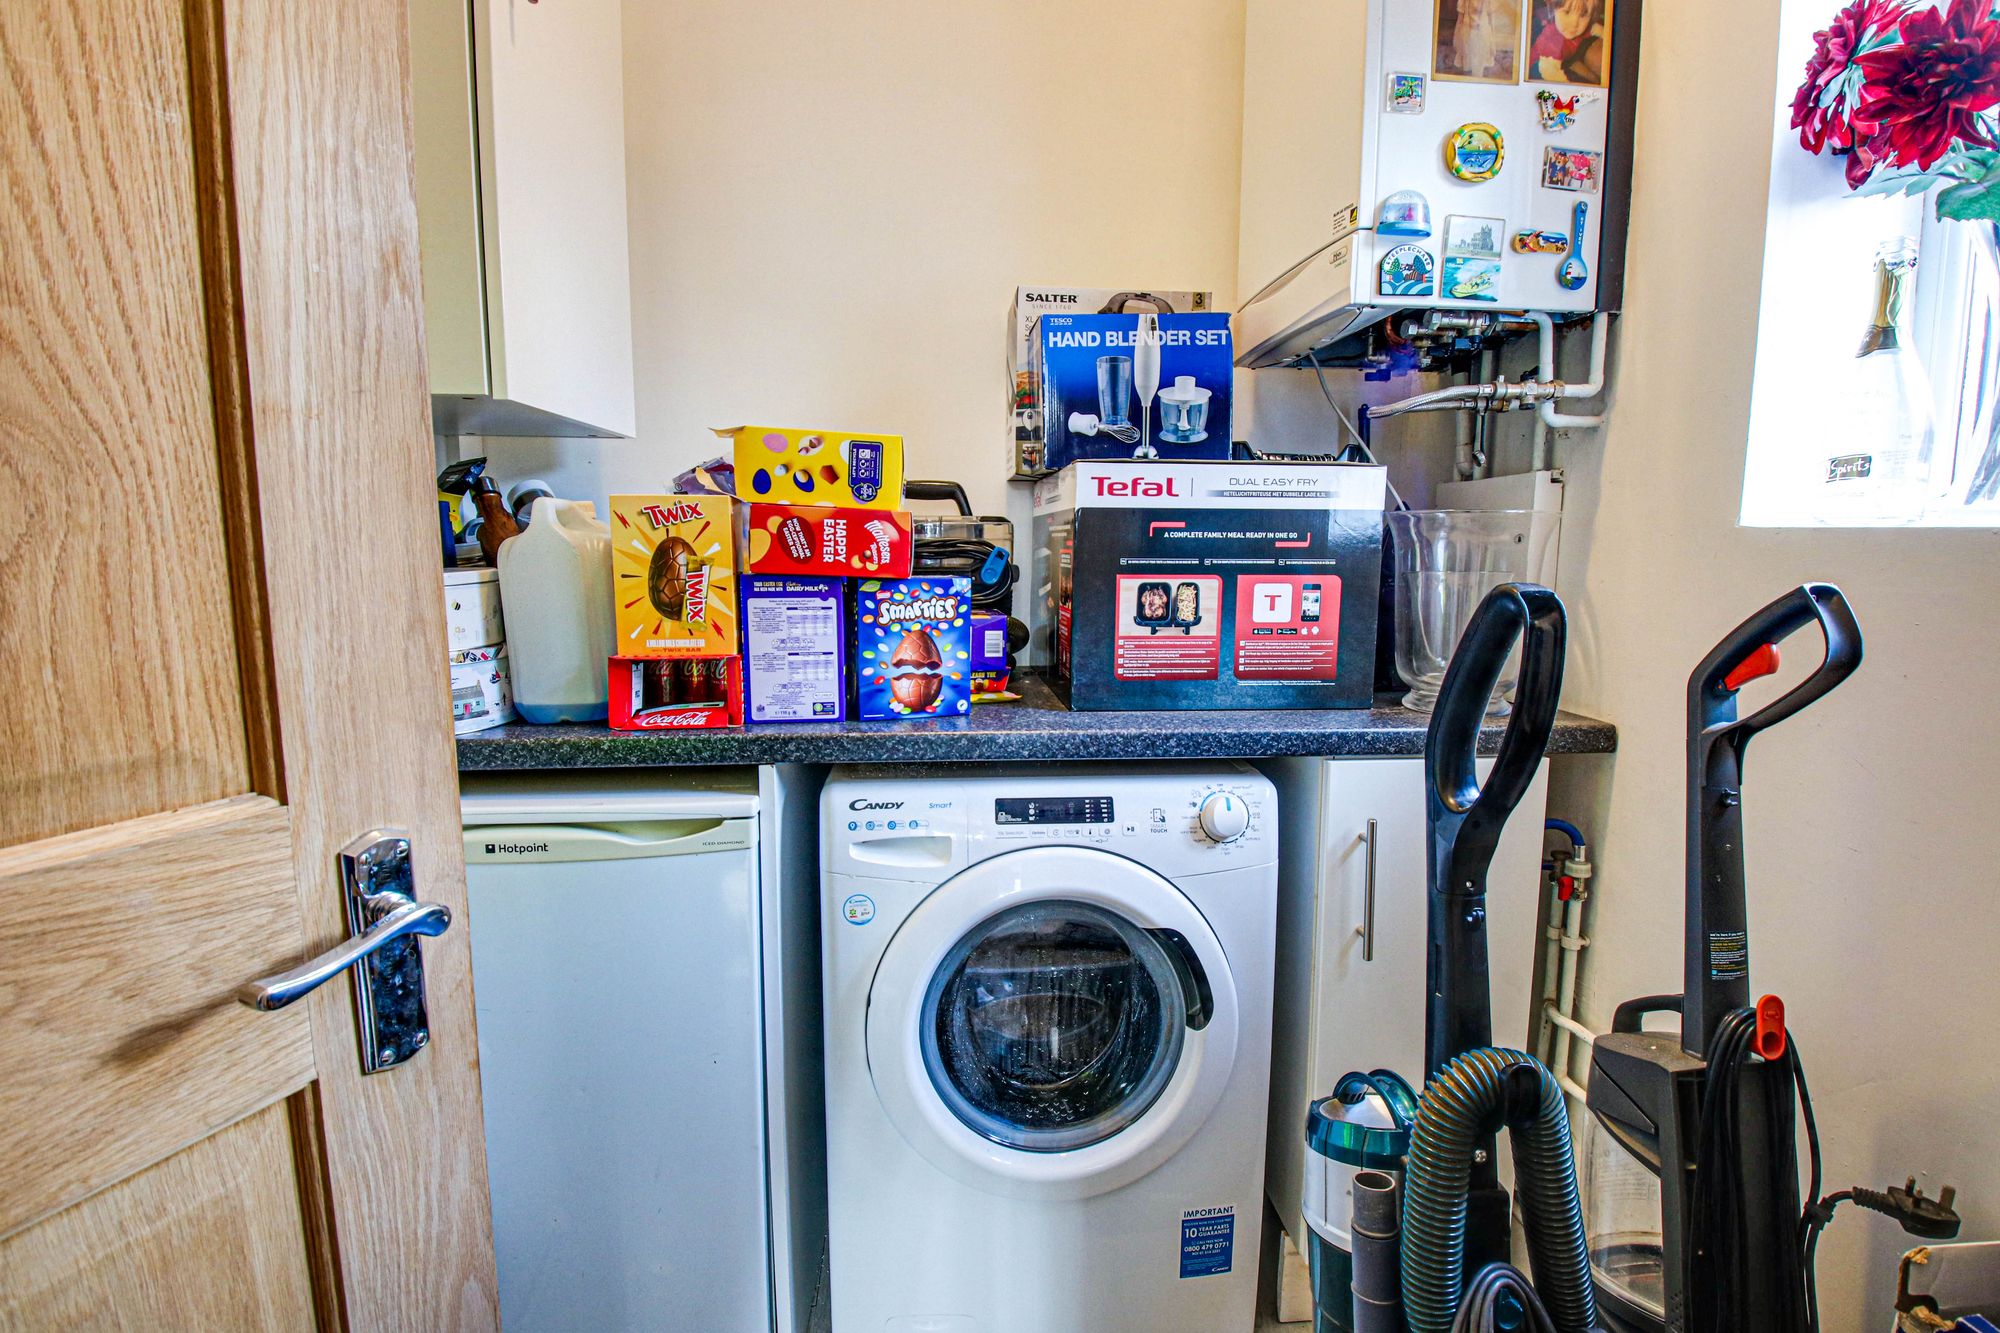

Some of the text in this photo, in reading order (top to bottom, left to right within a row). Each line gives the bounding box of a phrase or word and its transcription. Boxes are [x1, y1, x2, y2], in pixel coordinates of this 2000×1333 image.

[1025, 293, 1078, 303] SALTER
[1195, 292, 1203, 305] 3
[1049, 331, 1100, 347] HAND
[1105, 330, 1191, 347] BLENDER
[1194, 330, 1229, 345] SET
[1091, 477, 1180, 497] Tefal
[1229, 477, 1319, 486] DUAL EASY FRY
[782, 527, 799, 558] EASTER EGG
[791, 517, 802, 532] NOW
[804, 548, 812, 557] AN
[823, 518, 835, 563] EASTER
[835, 519, 847, 563] HAPPY
[863, 519, 891, 565] Maltesers
[1264, 594, 1282, 611] T
[641, 711, 712, 727] Coca-Cola
[498, 842, 549, 855] Hotpoint
[1183, 1205, 1234, 1218] IMPORTANT
[1185, 1227, 1198, 1239] 10
[1198, 1228, 1230, 1237] GUARANTEE
